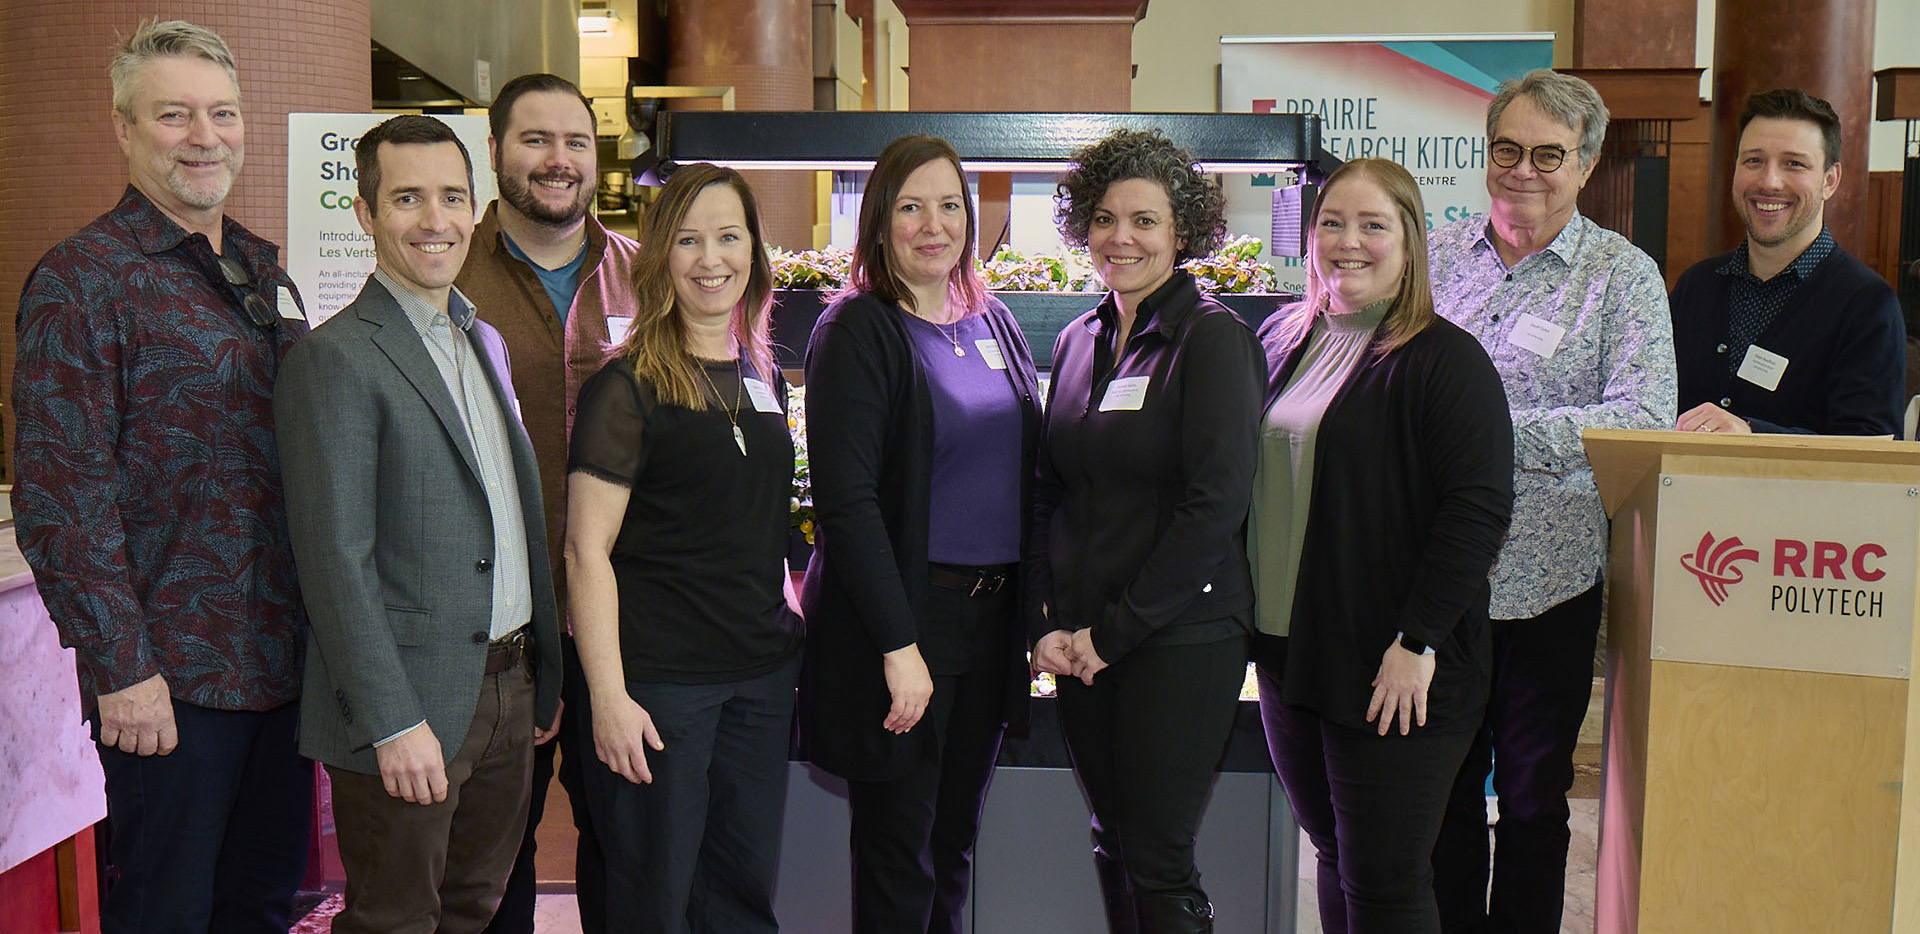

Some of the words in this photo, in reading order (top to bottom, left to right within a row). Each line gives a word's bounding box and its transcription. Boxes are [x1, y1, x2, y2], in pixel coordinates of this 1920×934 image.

[1286, 97, 1377, 131] PRAIRIE
[1321, 135, 1406, 168] EARCH
[1417, 135, 1485, 169] KITCH
[1414, 176, 1456, 186] CENTRE
[320, 190, 353, 211] Co
[1444, 205, 1482, 223] St
[319, 246, 341, 258] Les
[344, 246, 376, 258] Verts
[319, 270, 330, 278] An
[318, 281, 357, 290] providing
[1773, 539, 1888, 583] RRC
[1771, 585, 1883, 618] POLYTECH
